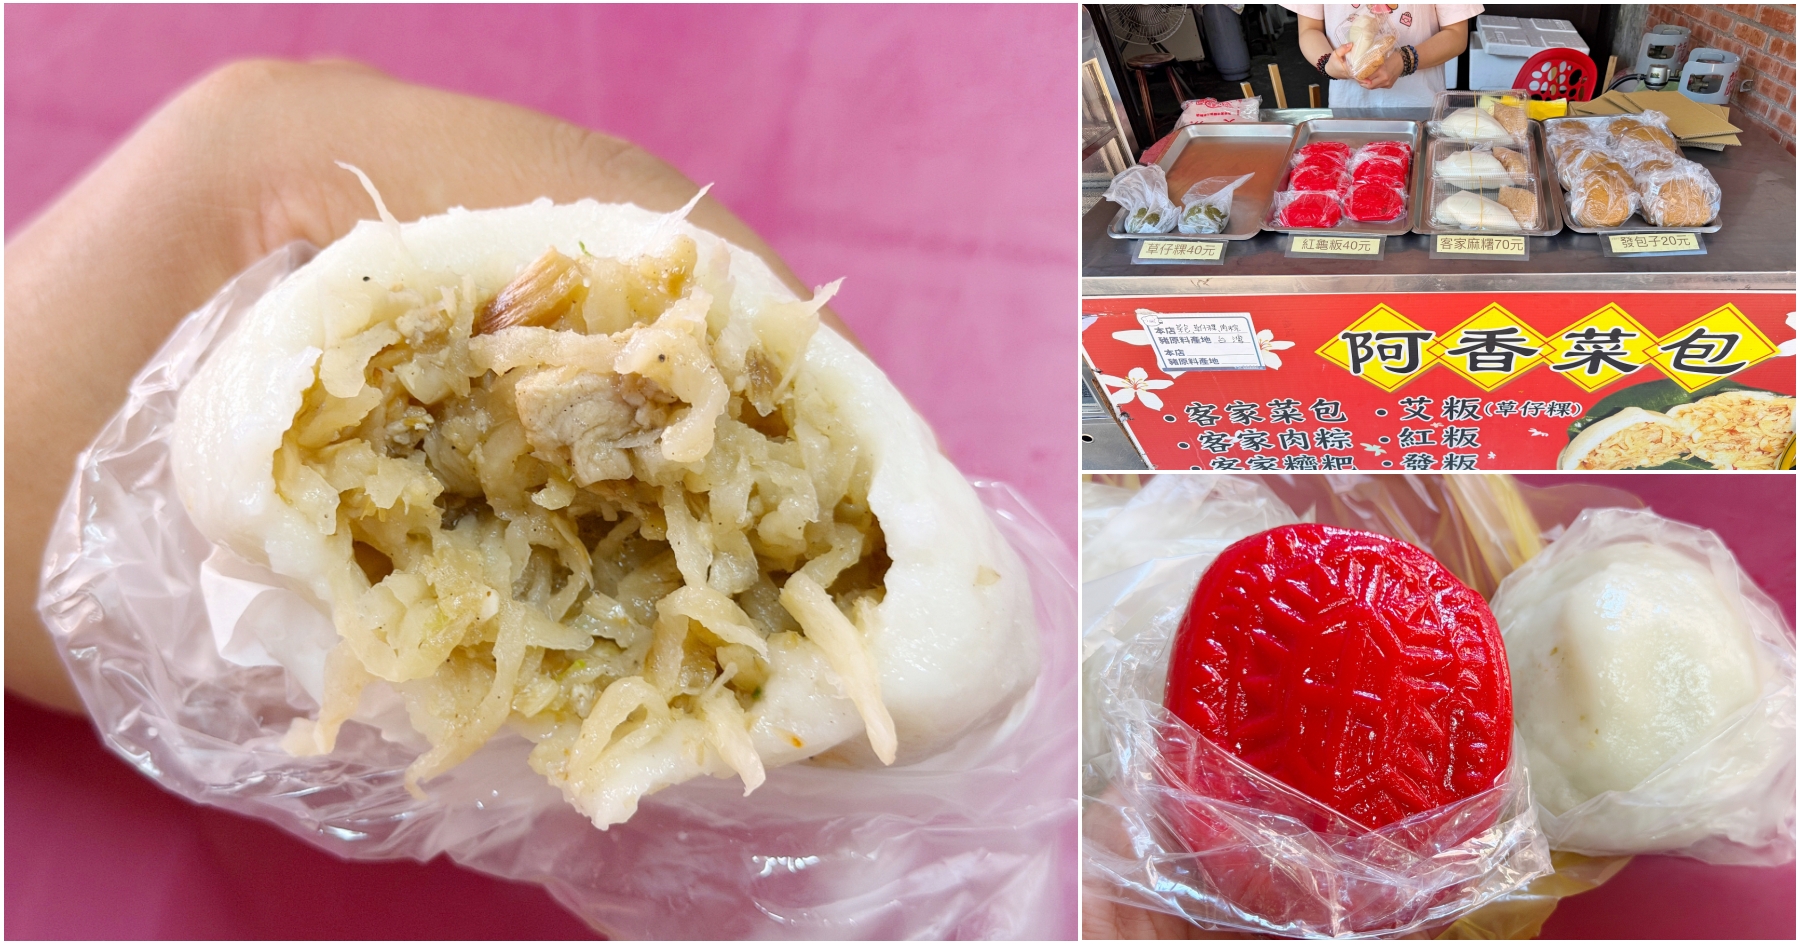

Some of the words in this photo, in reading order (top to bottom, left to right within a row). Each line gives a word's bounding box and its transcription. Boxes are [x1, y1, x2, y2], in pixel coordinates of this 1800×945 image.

[1164, 349, 1185, 357] 本店
[1342, 327, 1748, 374] 阿香菜包
[1186, 399, 1347, 426] 客家菜包
[1200, 429, 1352, 452] 客家肉粽
